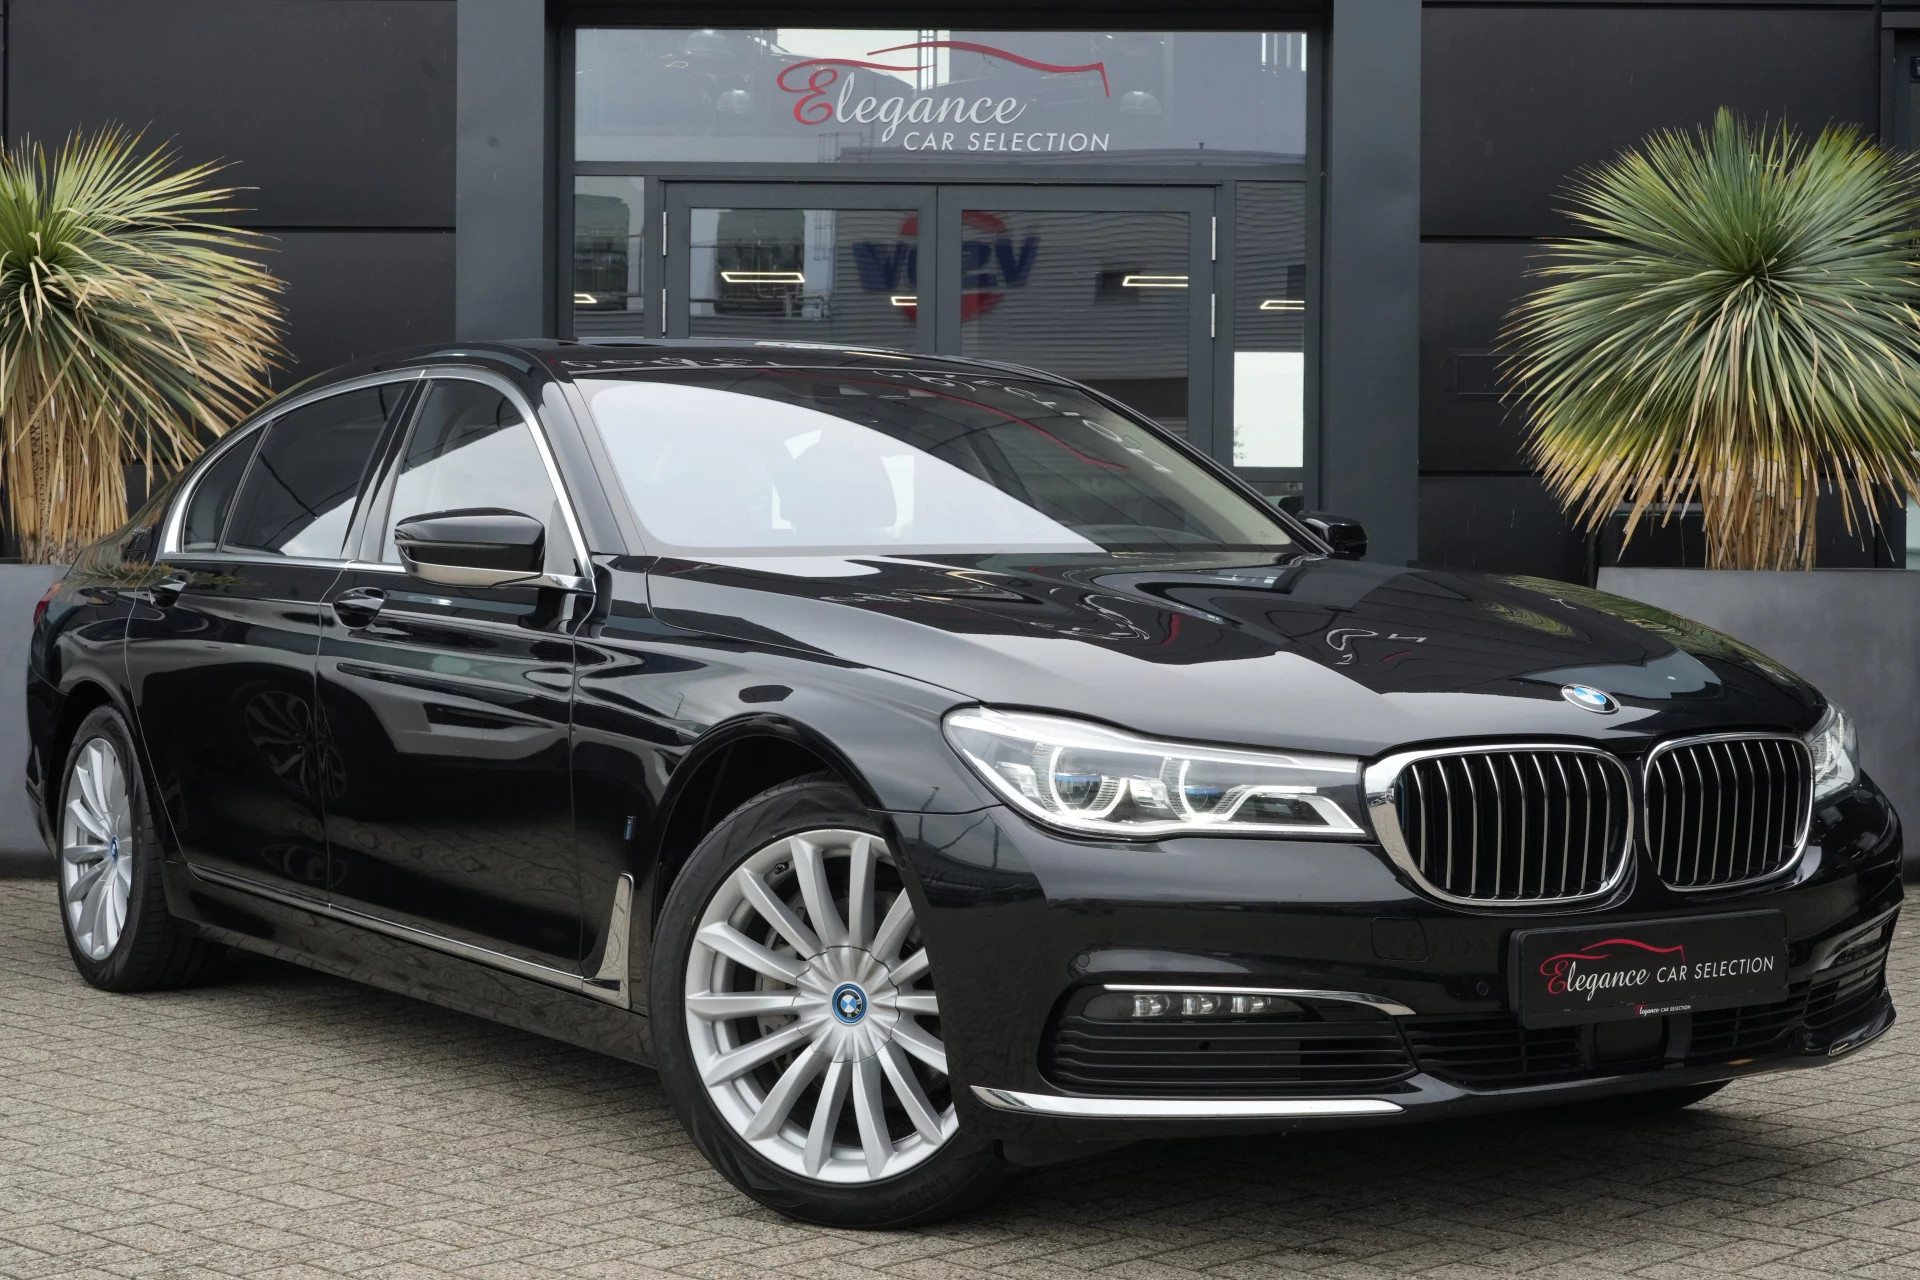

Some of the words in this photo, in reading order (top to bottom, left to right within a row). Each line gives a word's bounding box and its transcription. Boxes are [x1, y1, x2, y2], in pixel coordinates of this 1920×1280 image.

[777, 59, 1026, 143] Elegance
[903, 132, 955, 151] CAR
[967, 132, 1109, 152] SELECTION
[1540, 954, 1650, 1001] Elegance
[1656, 965, 1687, 983] CAR
[1694, 956, 1774, 980] SELECTION
